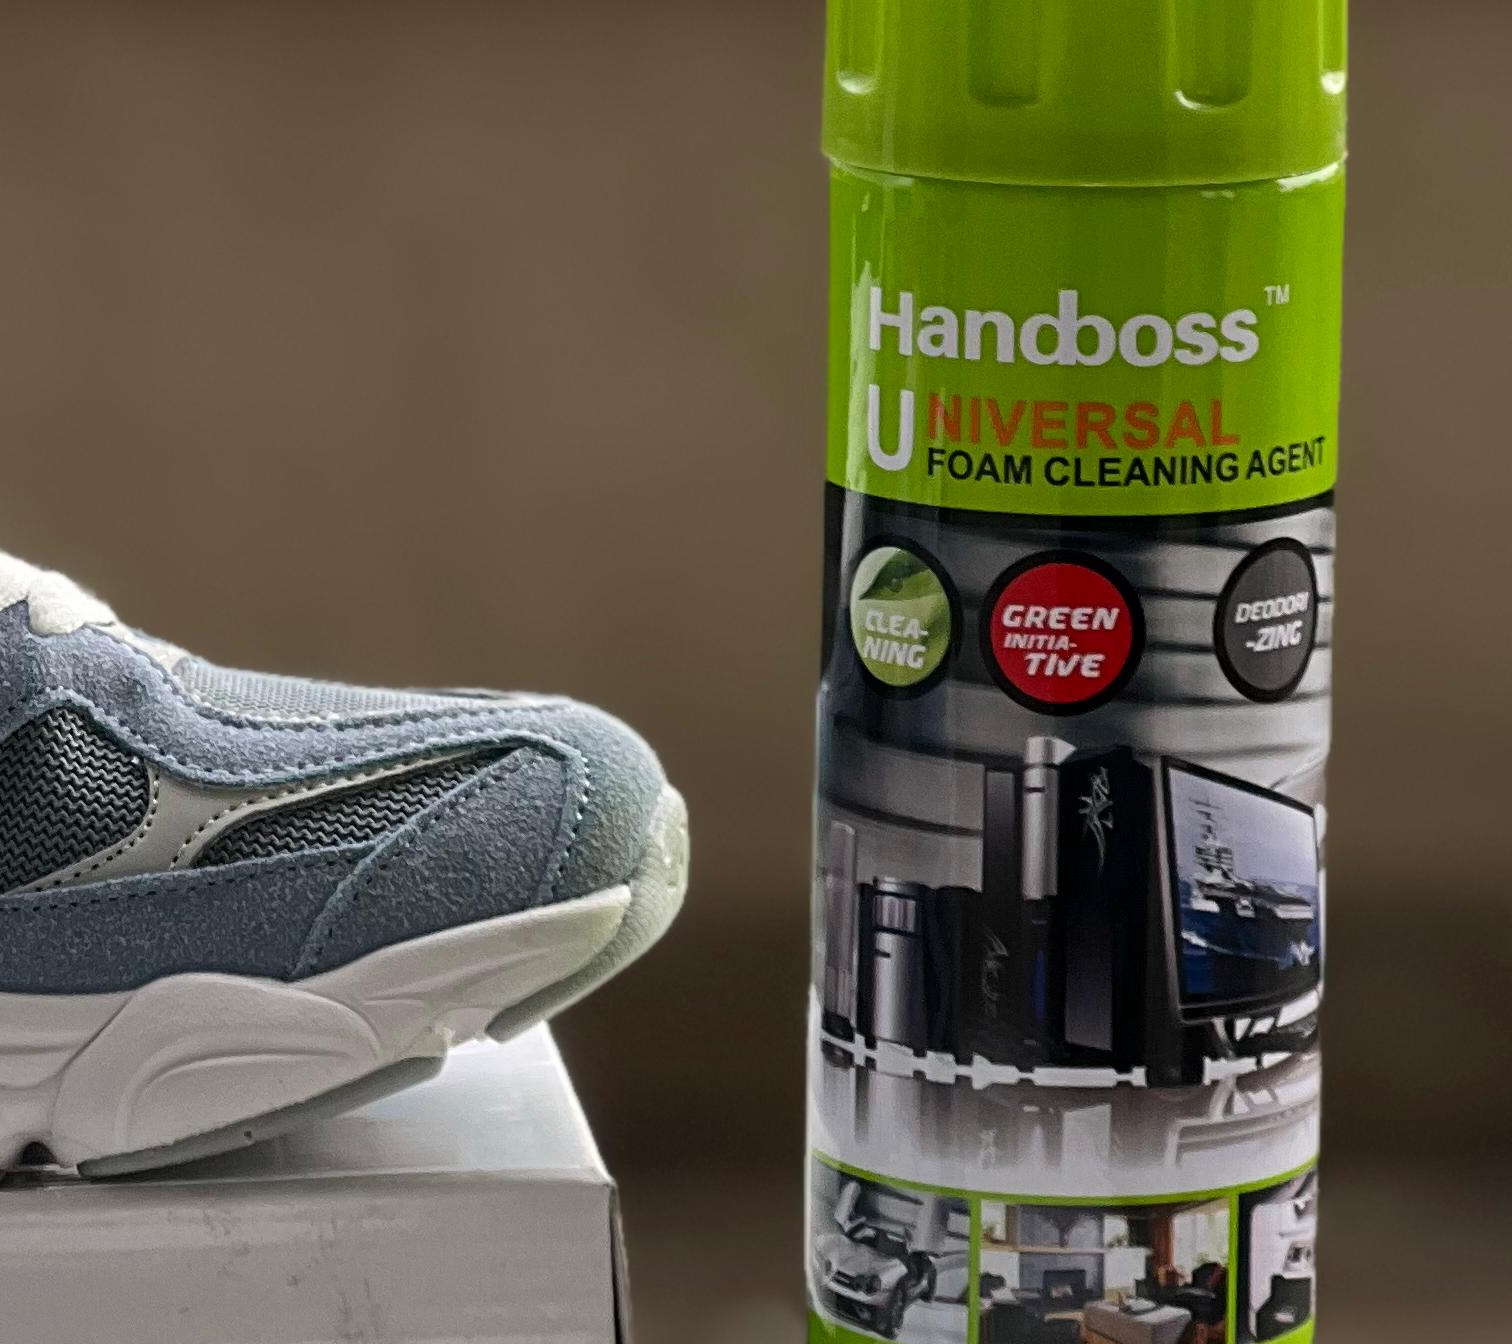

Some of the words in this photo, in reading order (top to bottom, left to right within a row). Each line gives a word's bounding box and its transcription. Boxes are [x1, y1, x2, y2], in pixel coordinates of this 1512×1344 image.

[868, 285, 1260, 368] Handboss
[867, 384, 1240, 472] UNIVERSAL
[927, 447, 1033, 485] FOAM
[1043, 452, 1240, 487] CLEANING
[1245, 436, 1326, 480] AGENT
[865, 608, 929, 640] CLEA-
[1002, 604, 1120, 631] GREEN
[863, 635, 926, 670] NING
[1004, 632, 1078, 651] INITIA-
[1245, 619, 1303, 653] -ZING
[1024, 652, 1106, 678] TIVE
